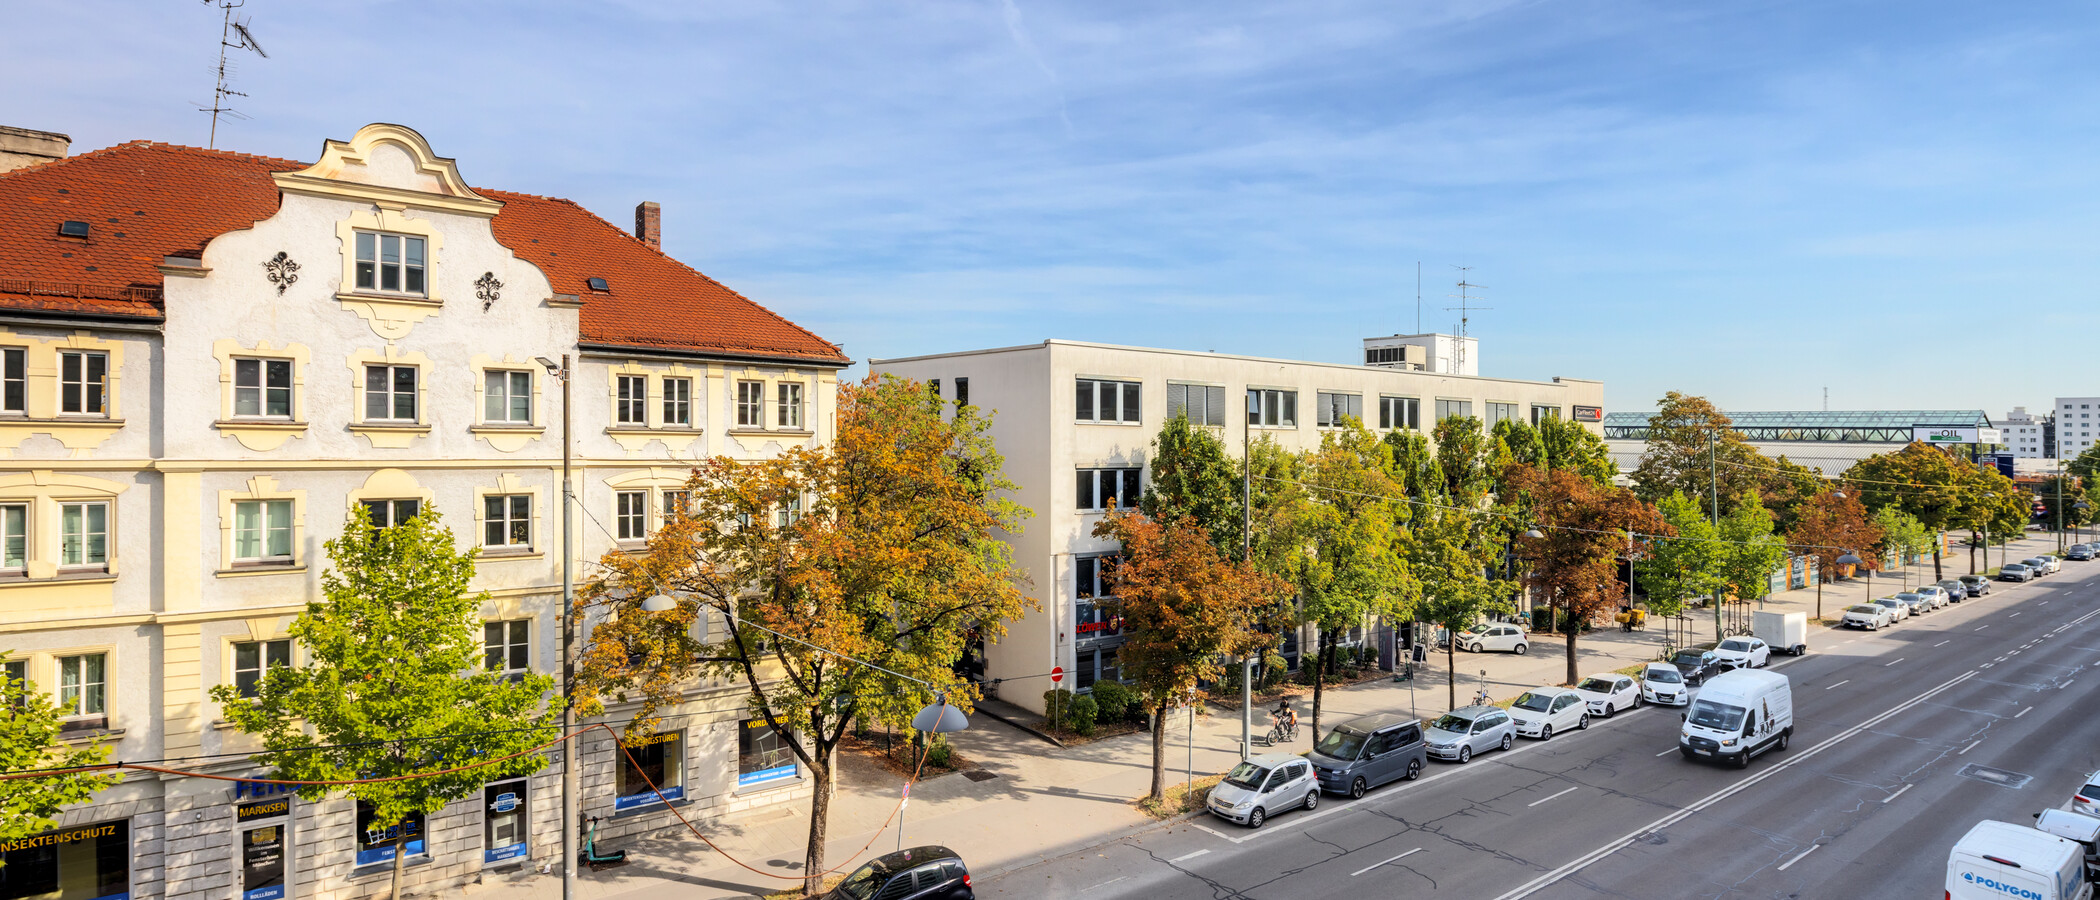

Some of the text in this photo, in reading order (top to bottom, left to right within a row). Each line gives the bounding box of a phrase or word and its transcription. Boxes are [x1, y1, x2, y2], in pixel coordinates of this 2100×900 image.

[1075, 621, 1107, 633] LÖWEN
[747, 715, 789, 729] VORDHER
[239, 802, 288, 817] MARKISEN
[0, 825, 116, 852] NSEKTENSCHUTZ
[1976, 876, 2042, 900] POLYGON
